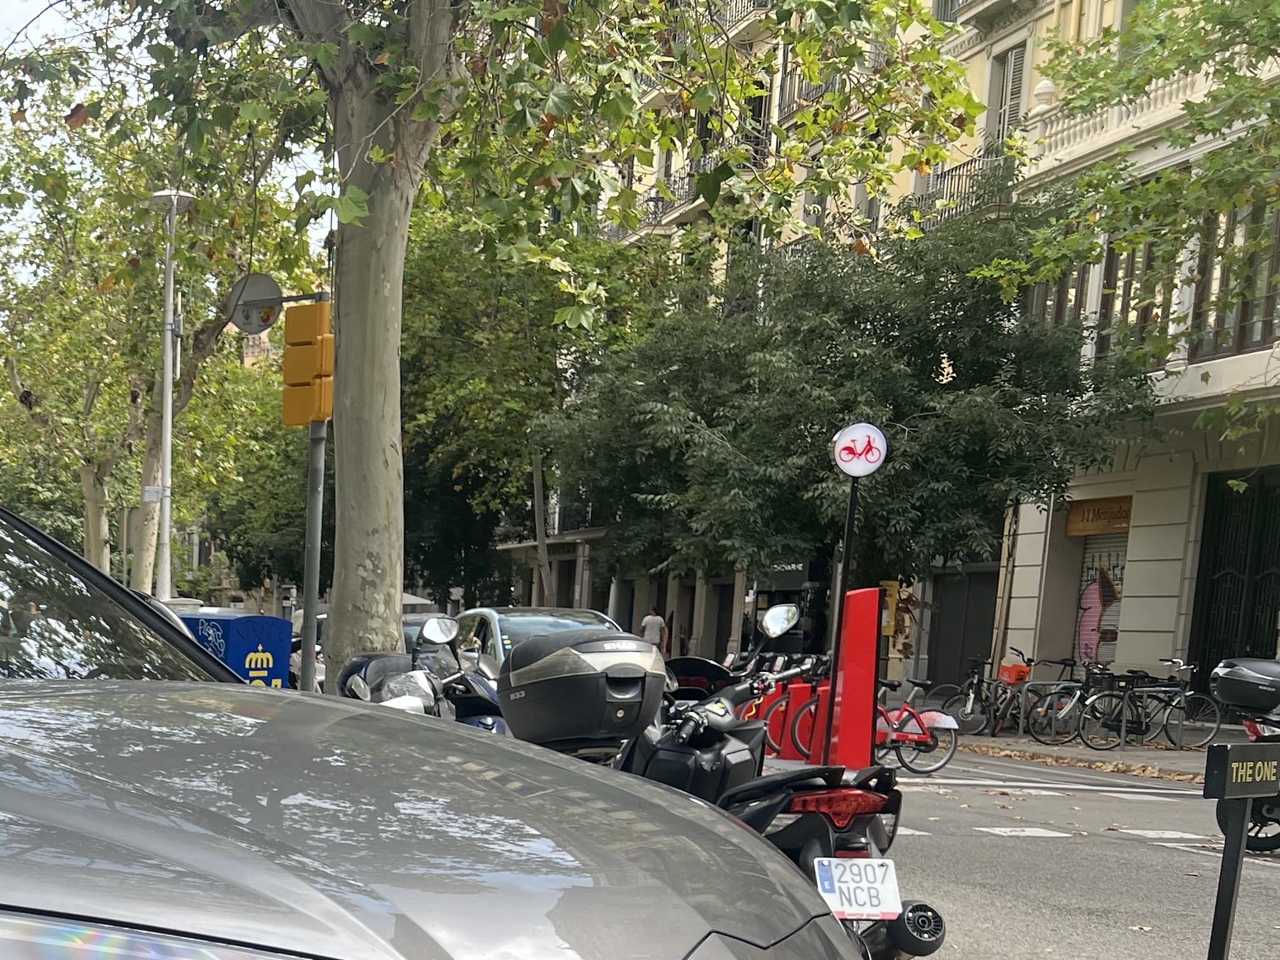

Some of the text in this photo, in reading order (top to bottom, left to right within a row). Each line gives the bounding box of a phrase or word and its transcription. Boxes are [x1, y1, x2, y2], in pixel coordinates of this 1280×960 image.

[1231, 761, 1277, 783] THE ONE
[835, 862, 889, 885] 2907
[824, 881, 831, 890] E
[838, 886, 881, 908] NCB
